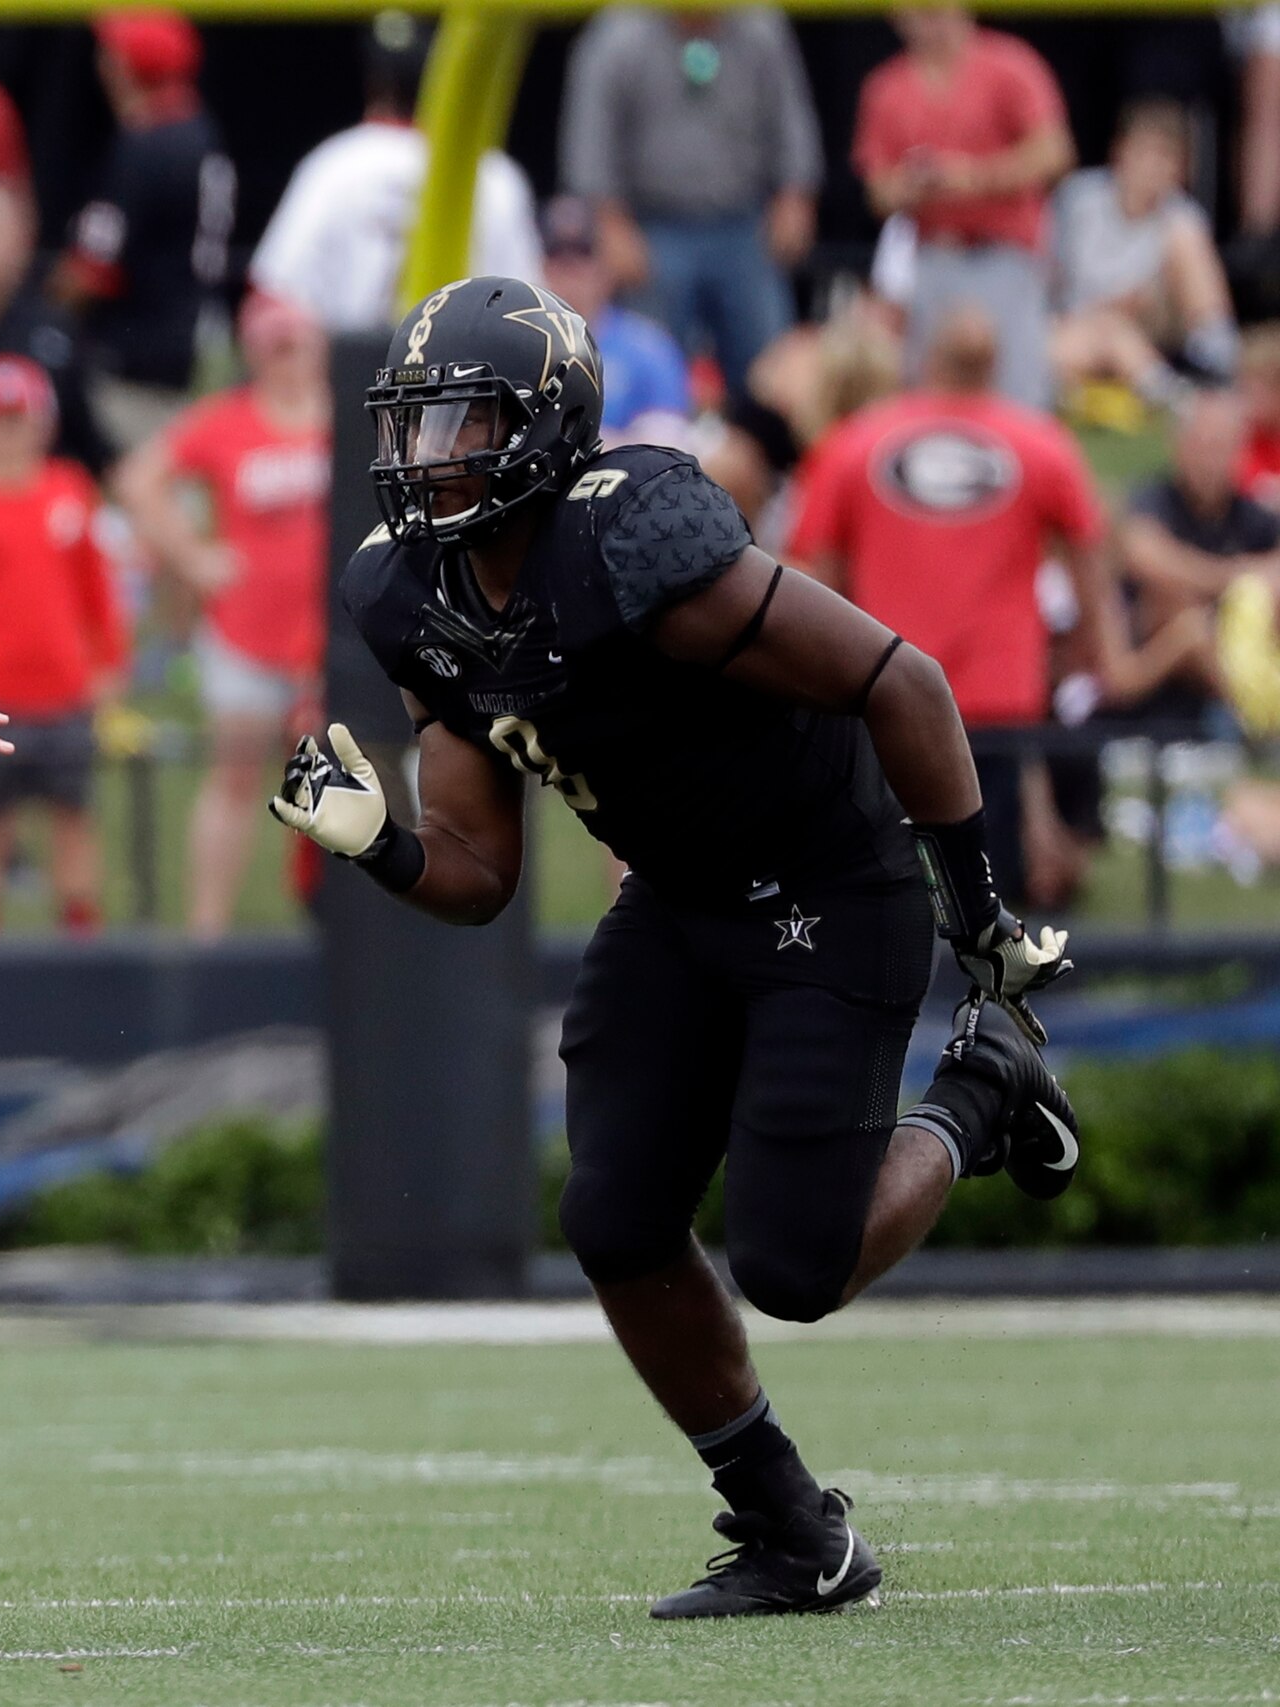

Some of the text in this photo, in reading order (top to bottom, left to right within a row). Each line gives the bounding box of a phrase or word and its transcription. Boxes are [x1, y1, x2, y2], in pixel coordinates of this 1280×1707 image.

[545, 312, 576, 354] V
[420, 648, 459, 677] SEC
[790, 921, 803, 937] V
